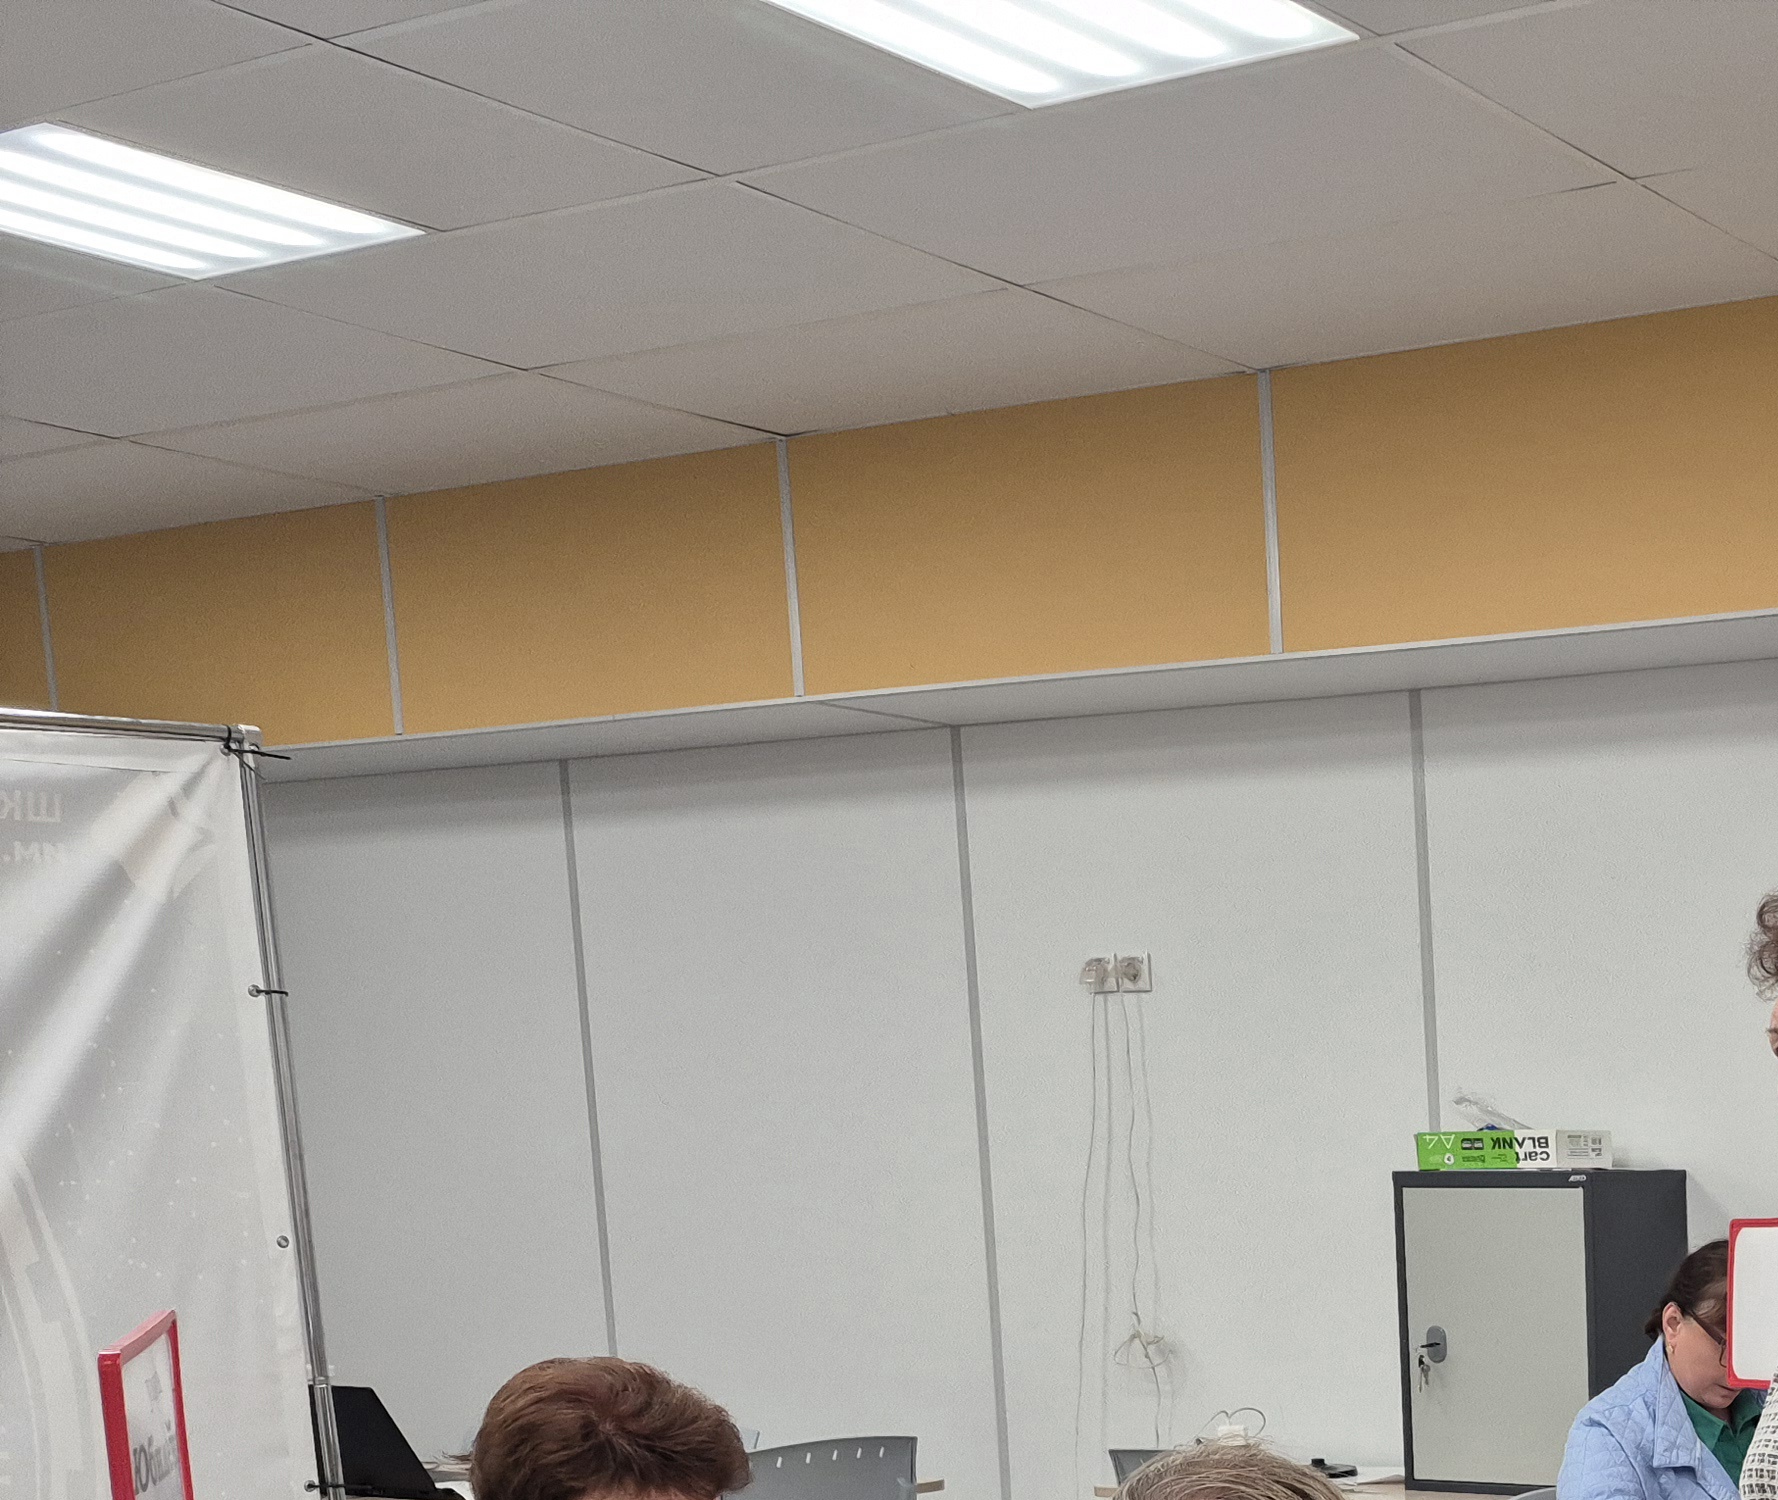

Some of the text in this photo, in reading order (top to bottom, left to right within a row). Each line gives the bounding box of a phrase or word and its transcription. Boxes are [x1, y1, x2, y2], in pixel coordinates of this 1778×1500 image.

[1423, 1134, 1455, 1150] A4
[1491, 1136, 1550, 1150] BLANK
[1515, 1151, 1551, 1164] cart
